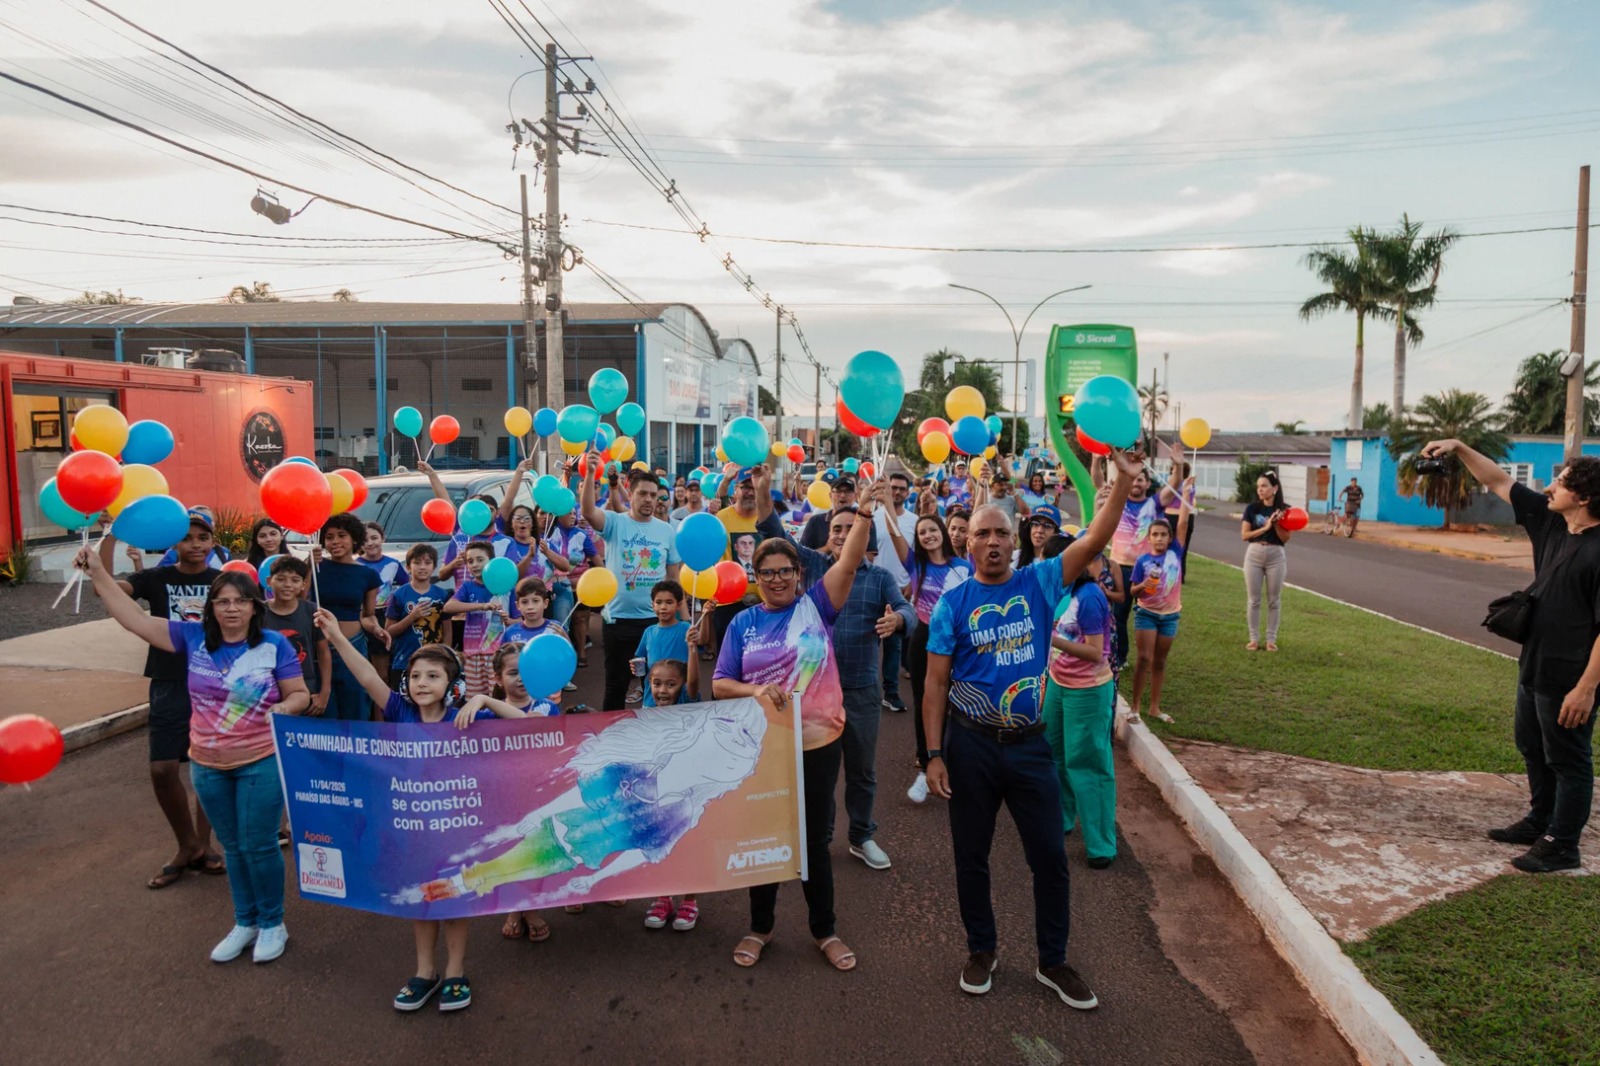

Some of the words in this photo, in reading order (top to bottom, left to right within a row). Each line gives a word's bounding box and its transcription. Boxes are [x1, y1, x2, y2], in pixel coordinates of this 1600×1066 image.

[1086, 334, 1117, 344] Sicredi
[166, 583, 212, 597] WANTE
[970, 627, 997, 647] UMA
[996, 650, 1012, 666] AO
[296, 733, 354, 753] CAMINHADA
[355, 737, 369, 755] DE
[370, 736, 479, 759] CONSCIENTIZAÇÃO
[481, 737, 501, 753] DO
[504, 731, 565, 751] AUTISMO
[310, 779, 346, 793] 11/04/2026
[390, 775, 478, 793] Autonomia
[319, 793, 331, 804] DAS
[392, 798, 408, 811] se
[411, 792, 482, 812] constrói
[393, 817, 424, 831] com
[429, 812, 484, 833] apoio.
[304, 830, 334, 845] Apoio:
[726, 845, 793, 872] AUTISMO
